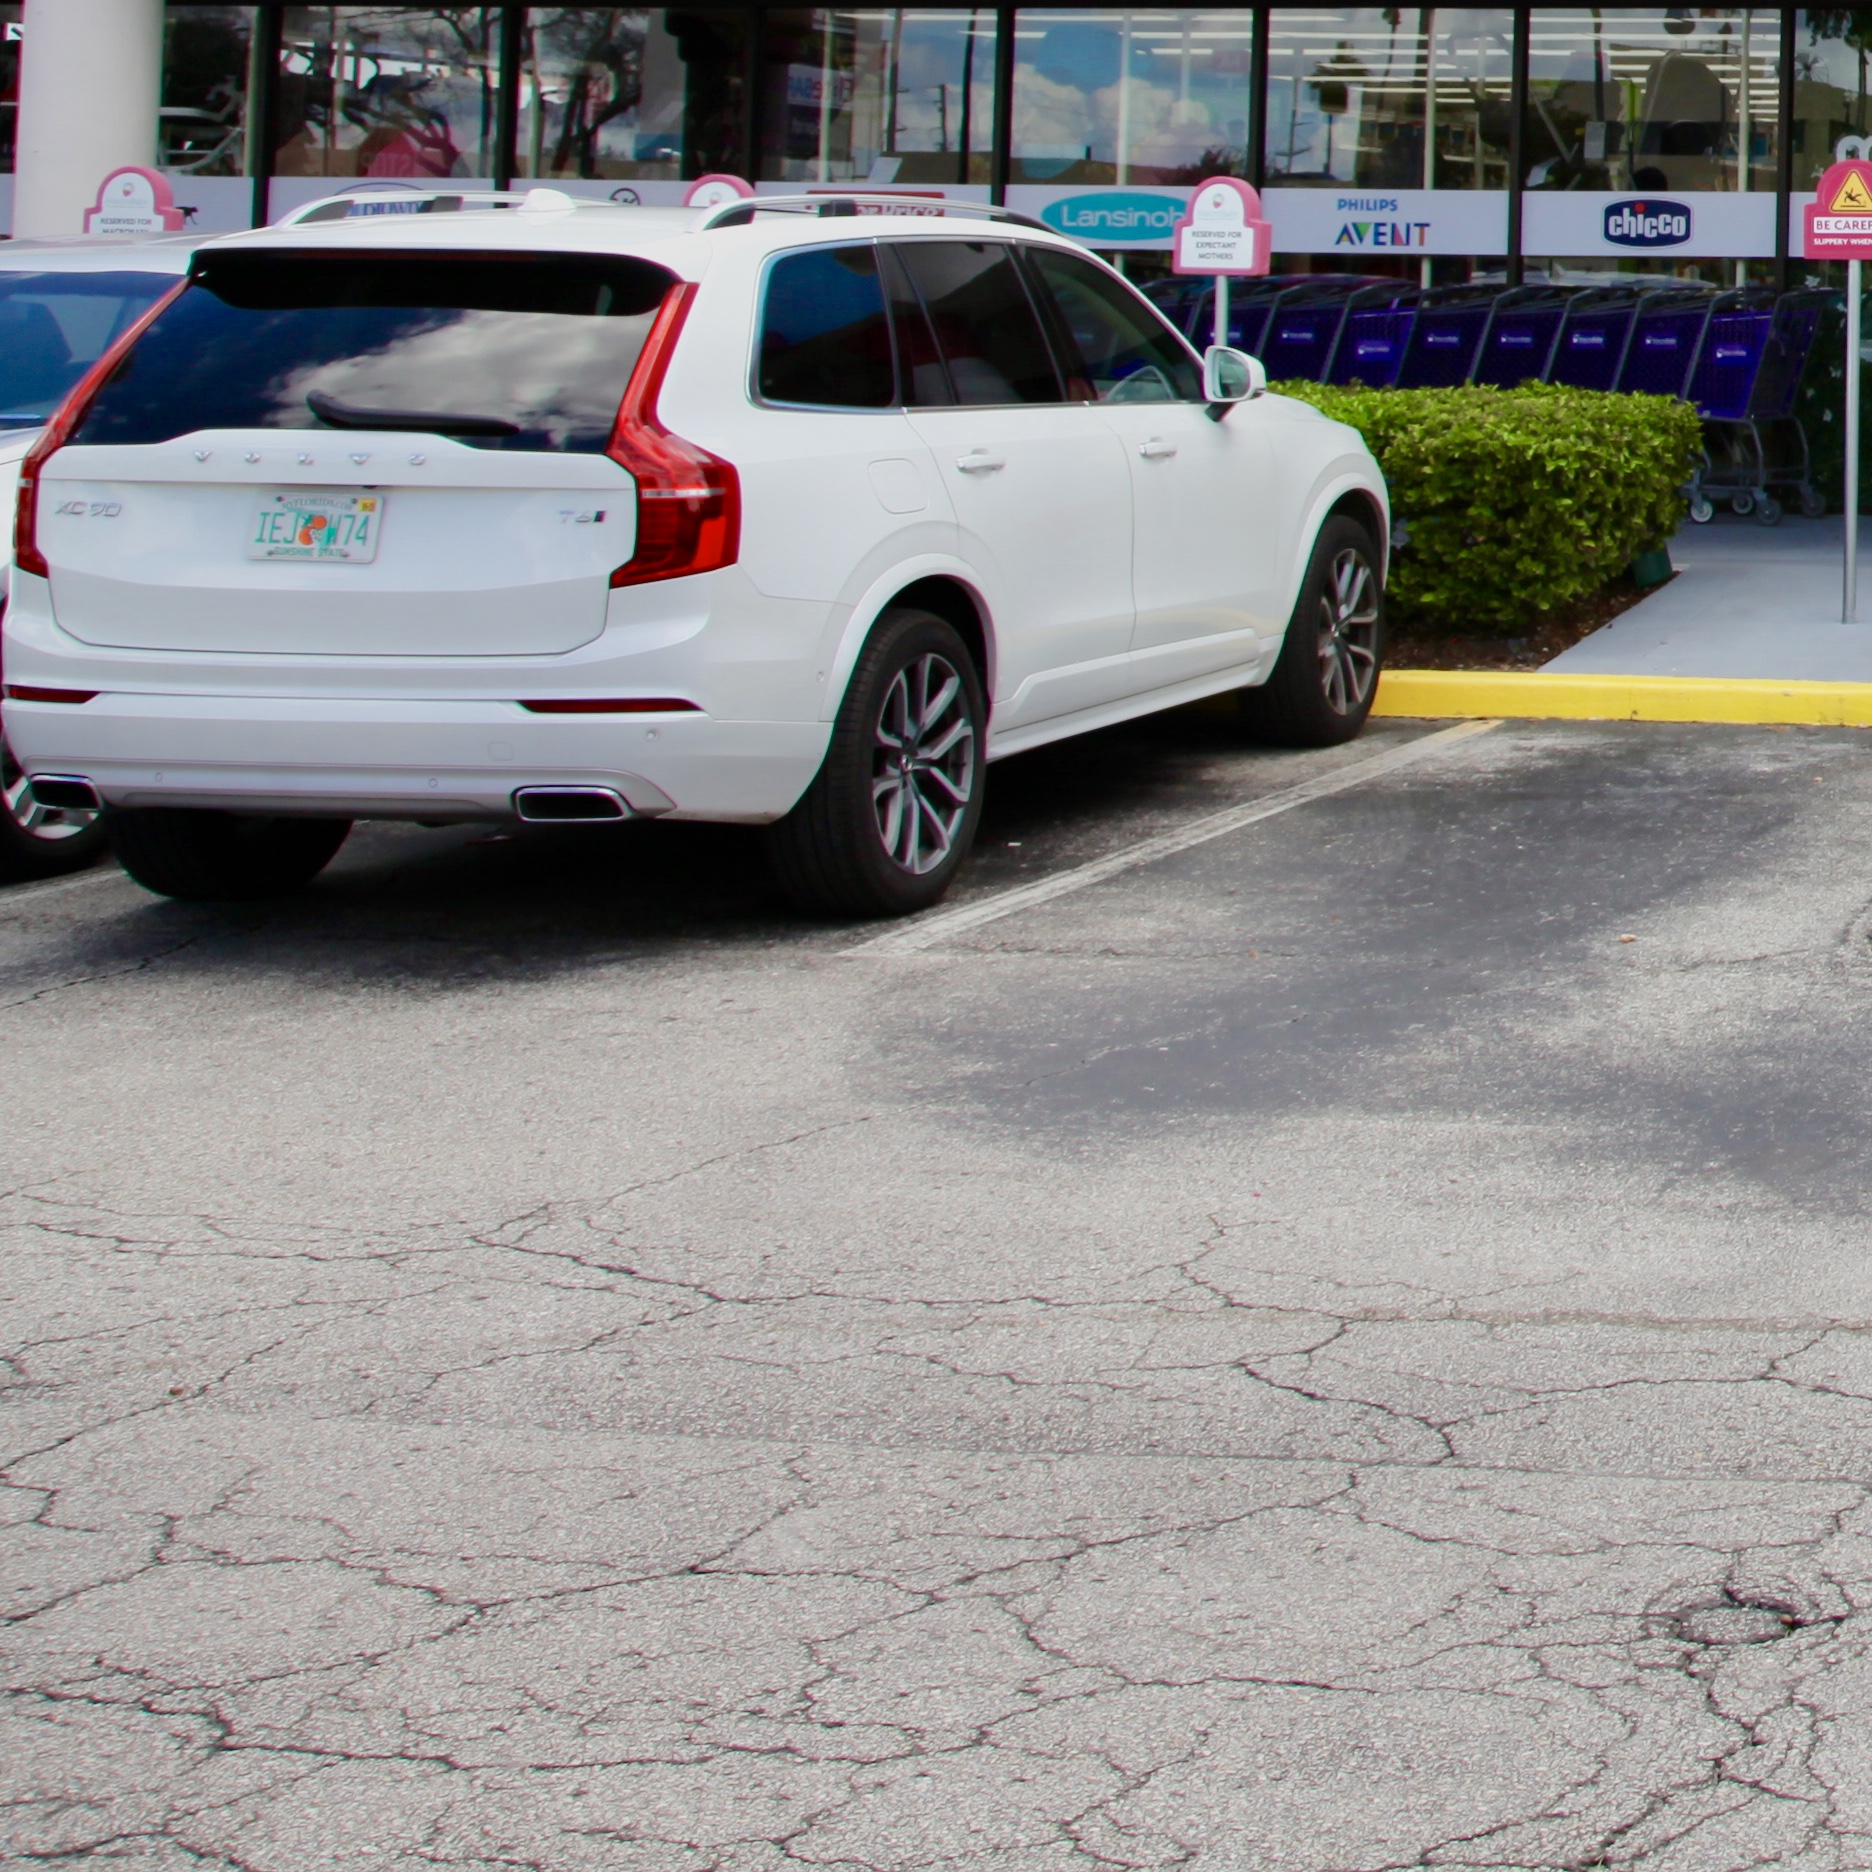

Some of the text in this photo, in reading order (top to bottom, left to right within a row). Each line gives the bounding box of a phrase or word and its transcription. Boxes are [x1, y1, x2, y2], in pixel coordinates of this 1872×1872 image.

[1337, 198, 1398, 212] PHILIPS
[1608, 203, 1687, 238] chicco
[1816, 220, 1831, 230] BE
[1335, 222, 1431, 246] AVENT
[193, 449, 428, 466] VOLVO
[254, 512, 301, 543] IEJ
